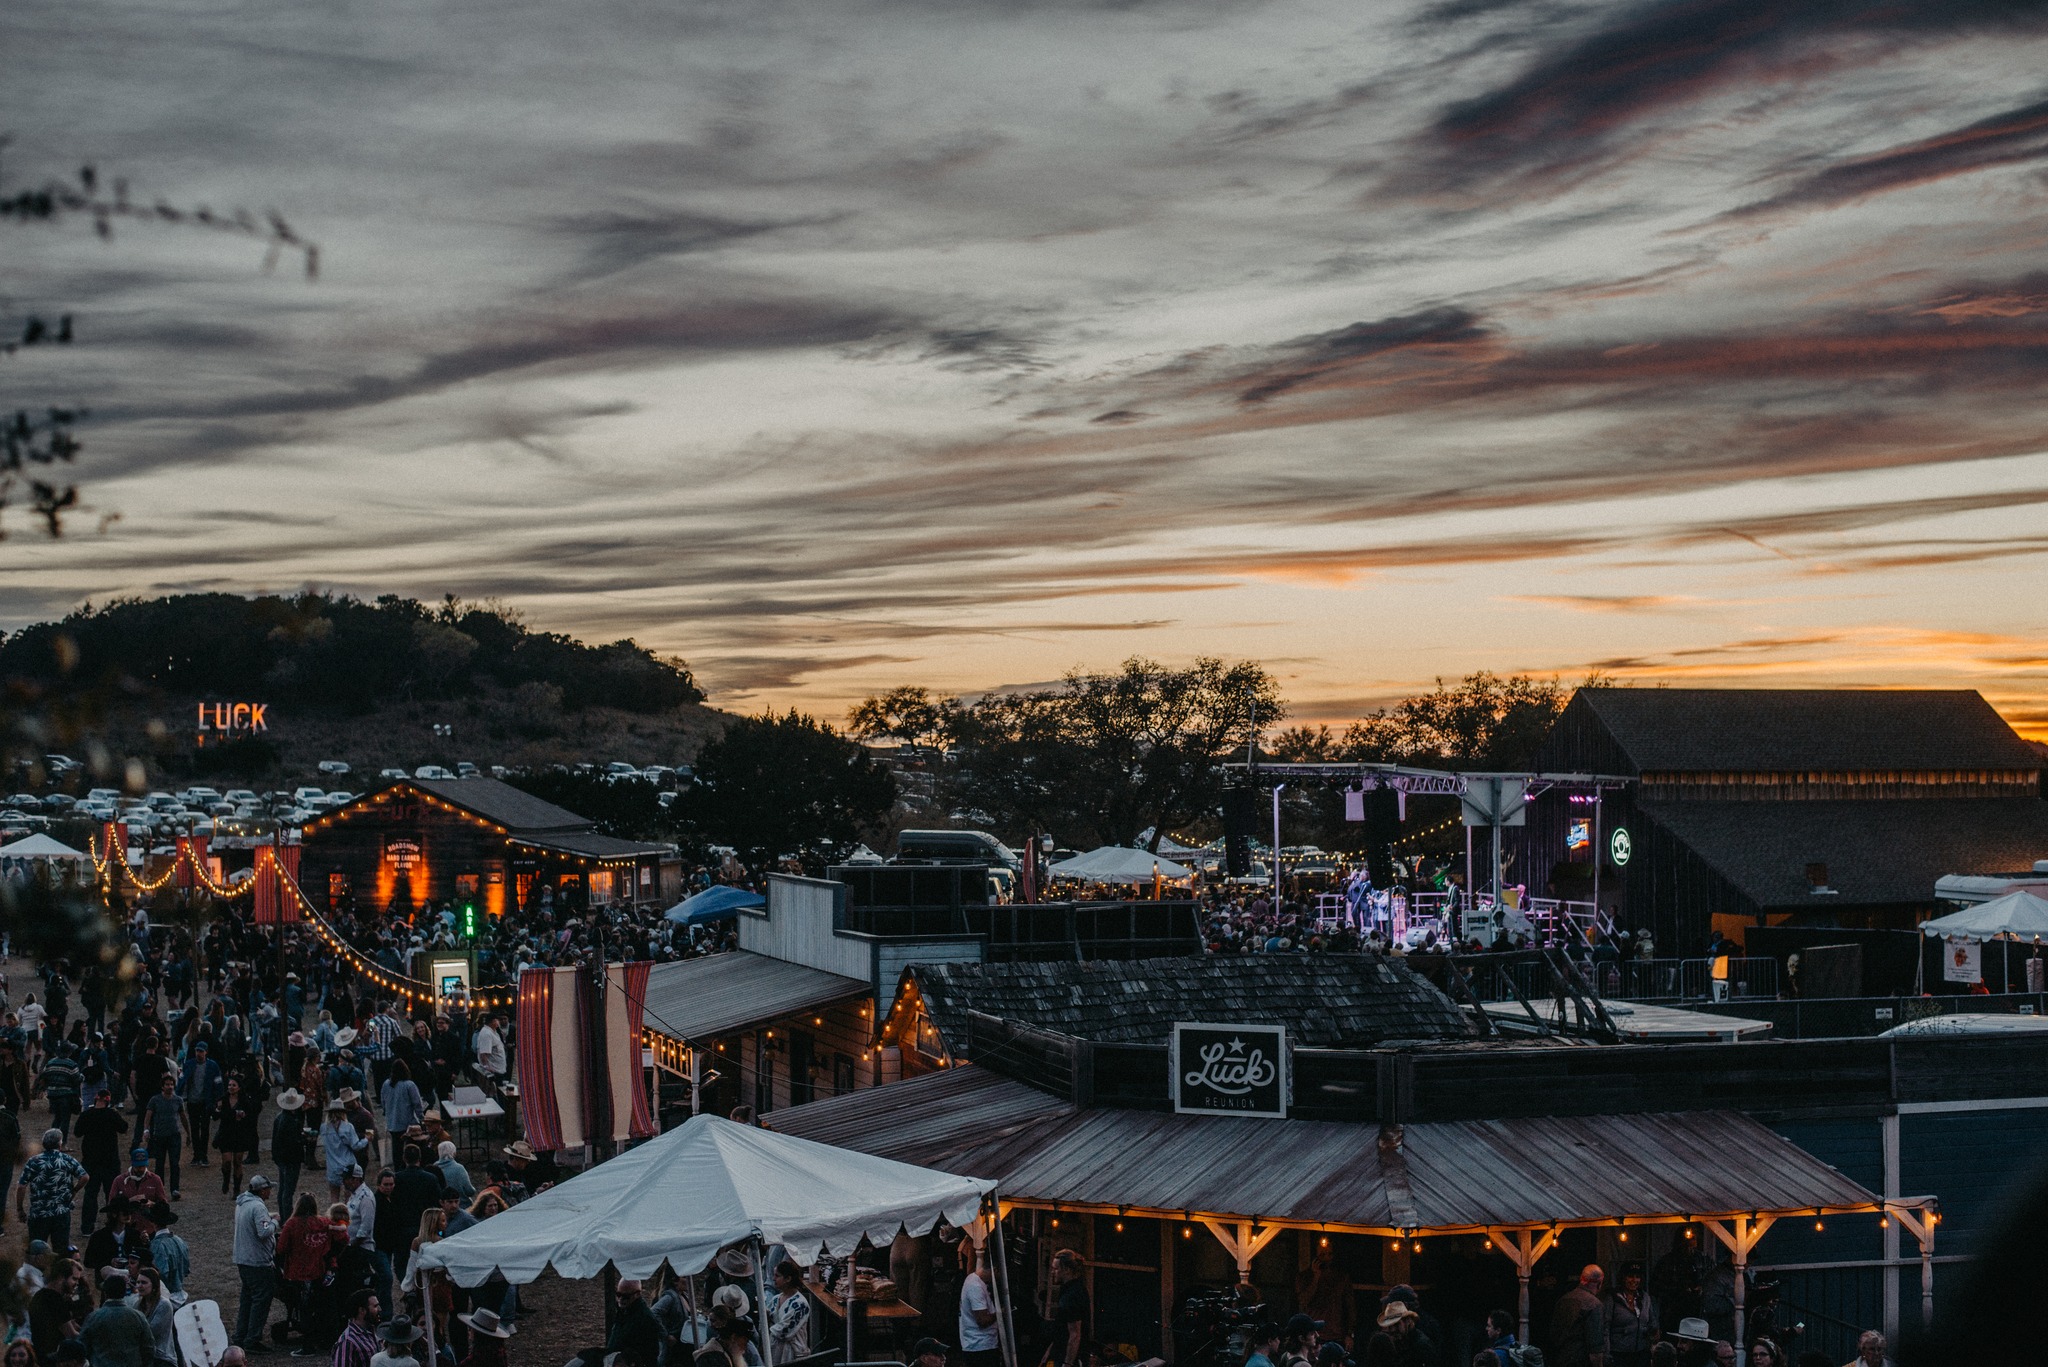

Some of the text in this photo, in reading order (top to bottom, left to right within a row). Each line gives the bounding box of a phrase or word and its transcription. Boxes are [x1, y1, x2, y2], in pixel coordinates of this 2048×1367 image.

[198, 702, 268, 731] LUCK
[466, 907, 474, 936] ATM
[1184, 1042, 1276, 1095] Luck
[1205, 1096, 1255, 1109] REUNION
